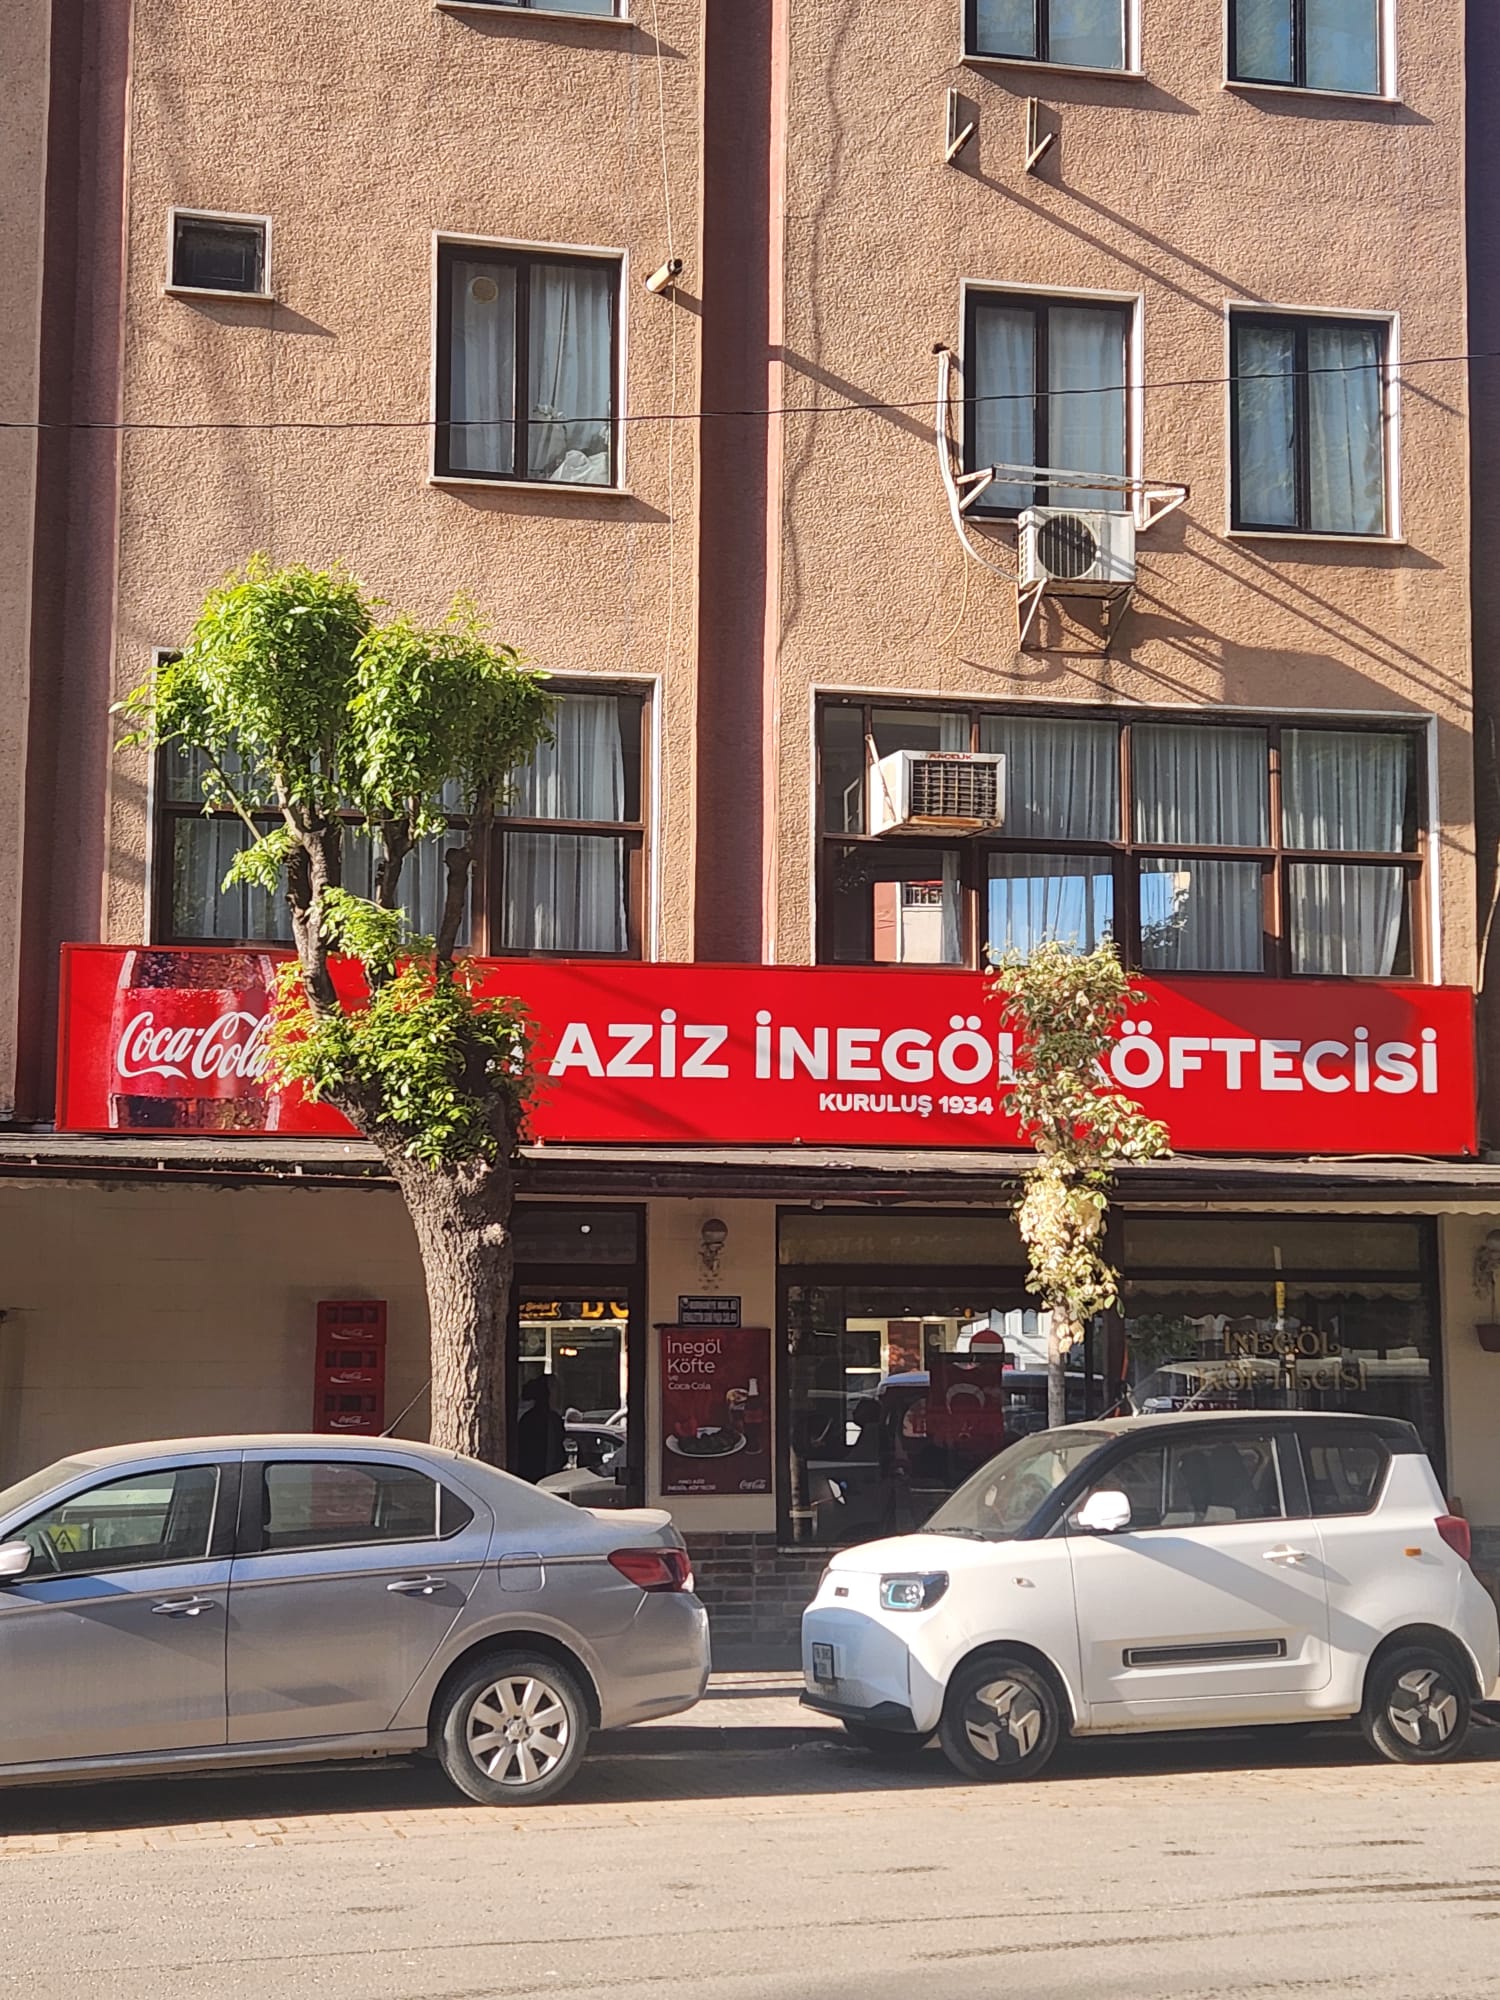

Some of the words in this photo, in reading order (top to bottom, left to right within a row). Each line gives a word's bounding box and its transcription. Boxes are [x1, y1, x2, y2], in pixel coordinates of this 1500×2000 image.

[117, 1011, 276, 1079] Coca-Cola
[548, 1009, 728, 1078] AZİZ
[756, 1010, 1020, 1084] İNEGÖL
[819, 1093, 932, 1117] KURULUŞ
[938, 1095, 994, 1115] 1934
[667, 1336, 722, 1357] İnegöl
[667, 1358, 715, 1374] Köfte
